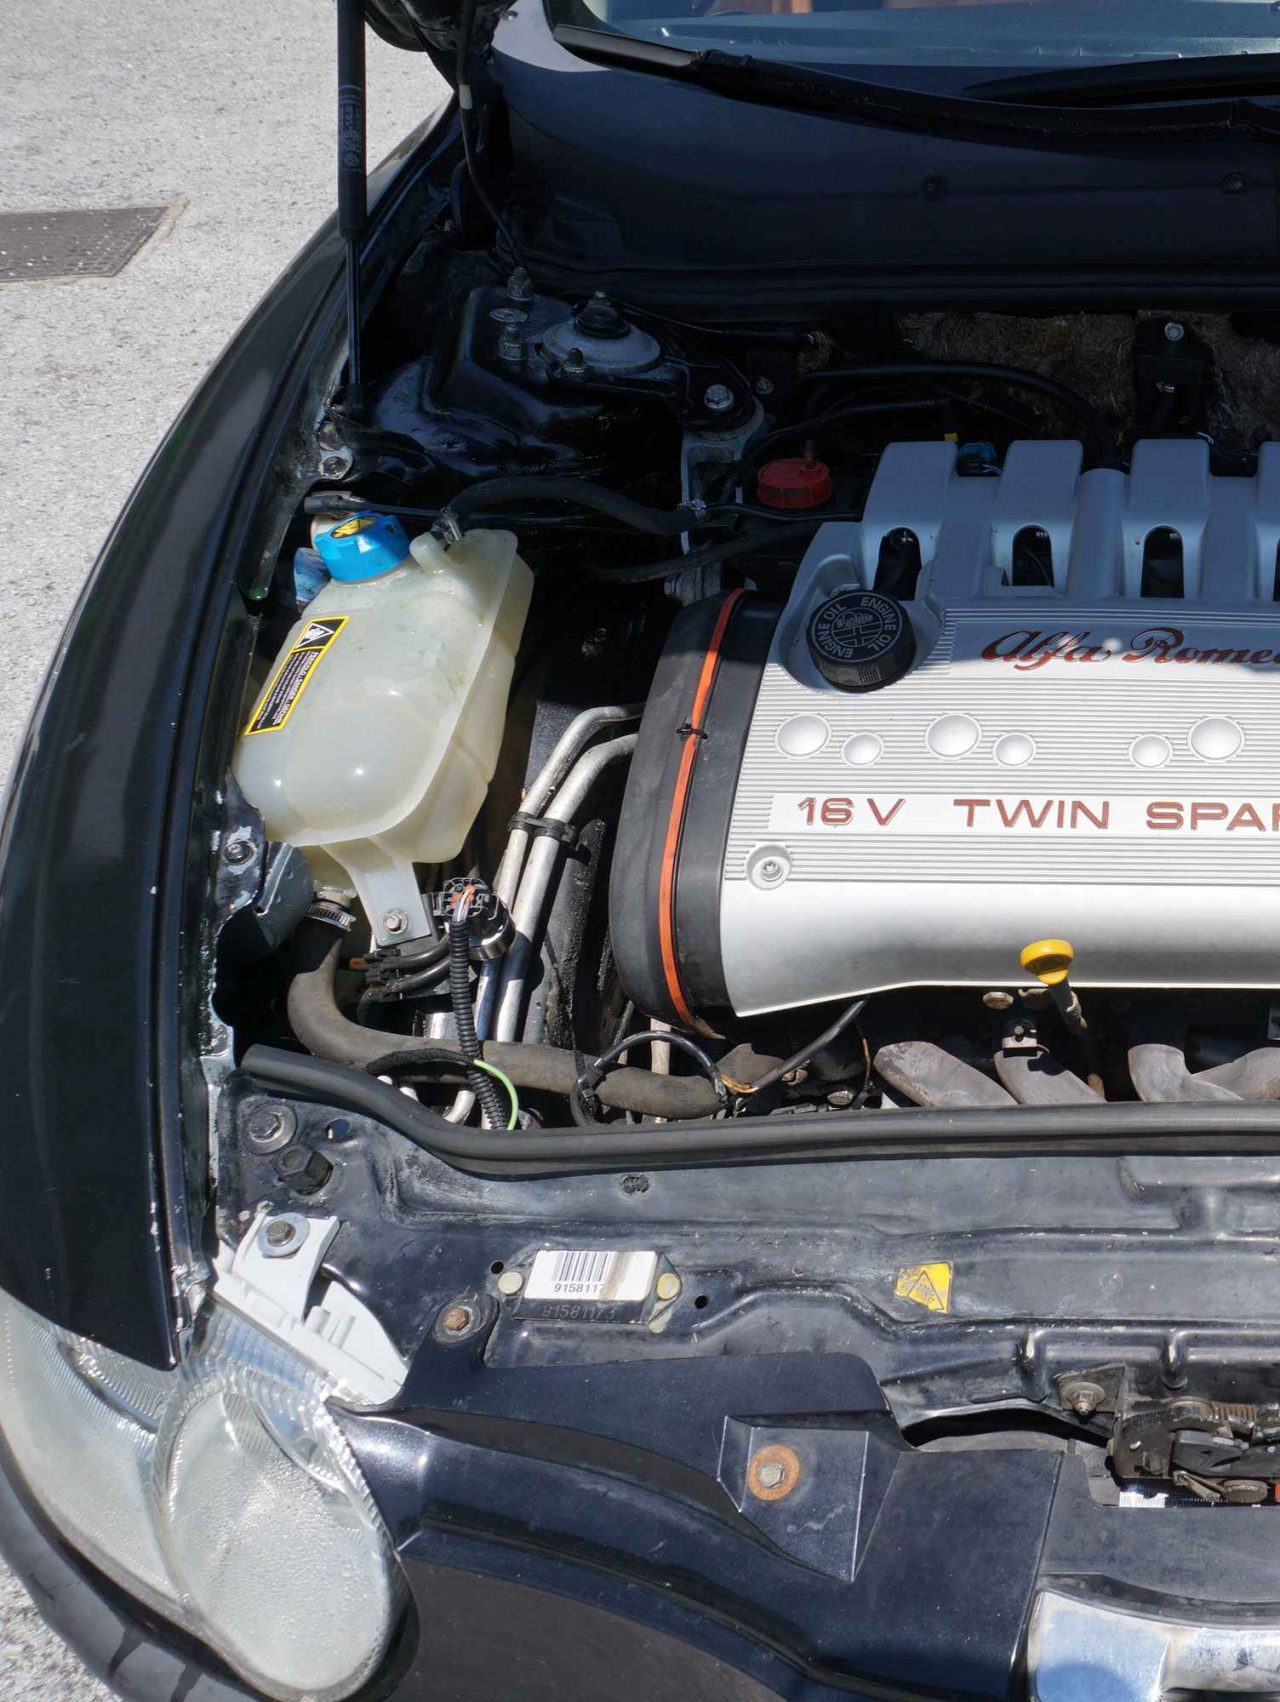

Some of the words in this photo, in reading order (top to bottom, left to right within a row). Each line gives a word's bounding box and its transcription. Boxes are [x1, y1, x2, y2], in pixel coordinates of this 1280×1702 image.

[823, 603, 847, 620] OIL
[861, 596, 896, 631] ENGINE
[817, 623, 854, 658] ENGINE
[868, 634, 891, 651] OIL
[981, 630, 1112, 672] Alfa
[798, 797, 854, 827] 16
[952, 798, 1111, 830] TWIN
